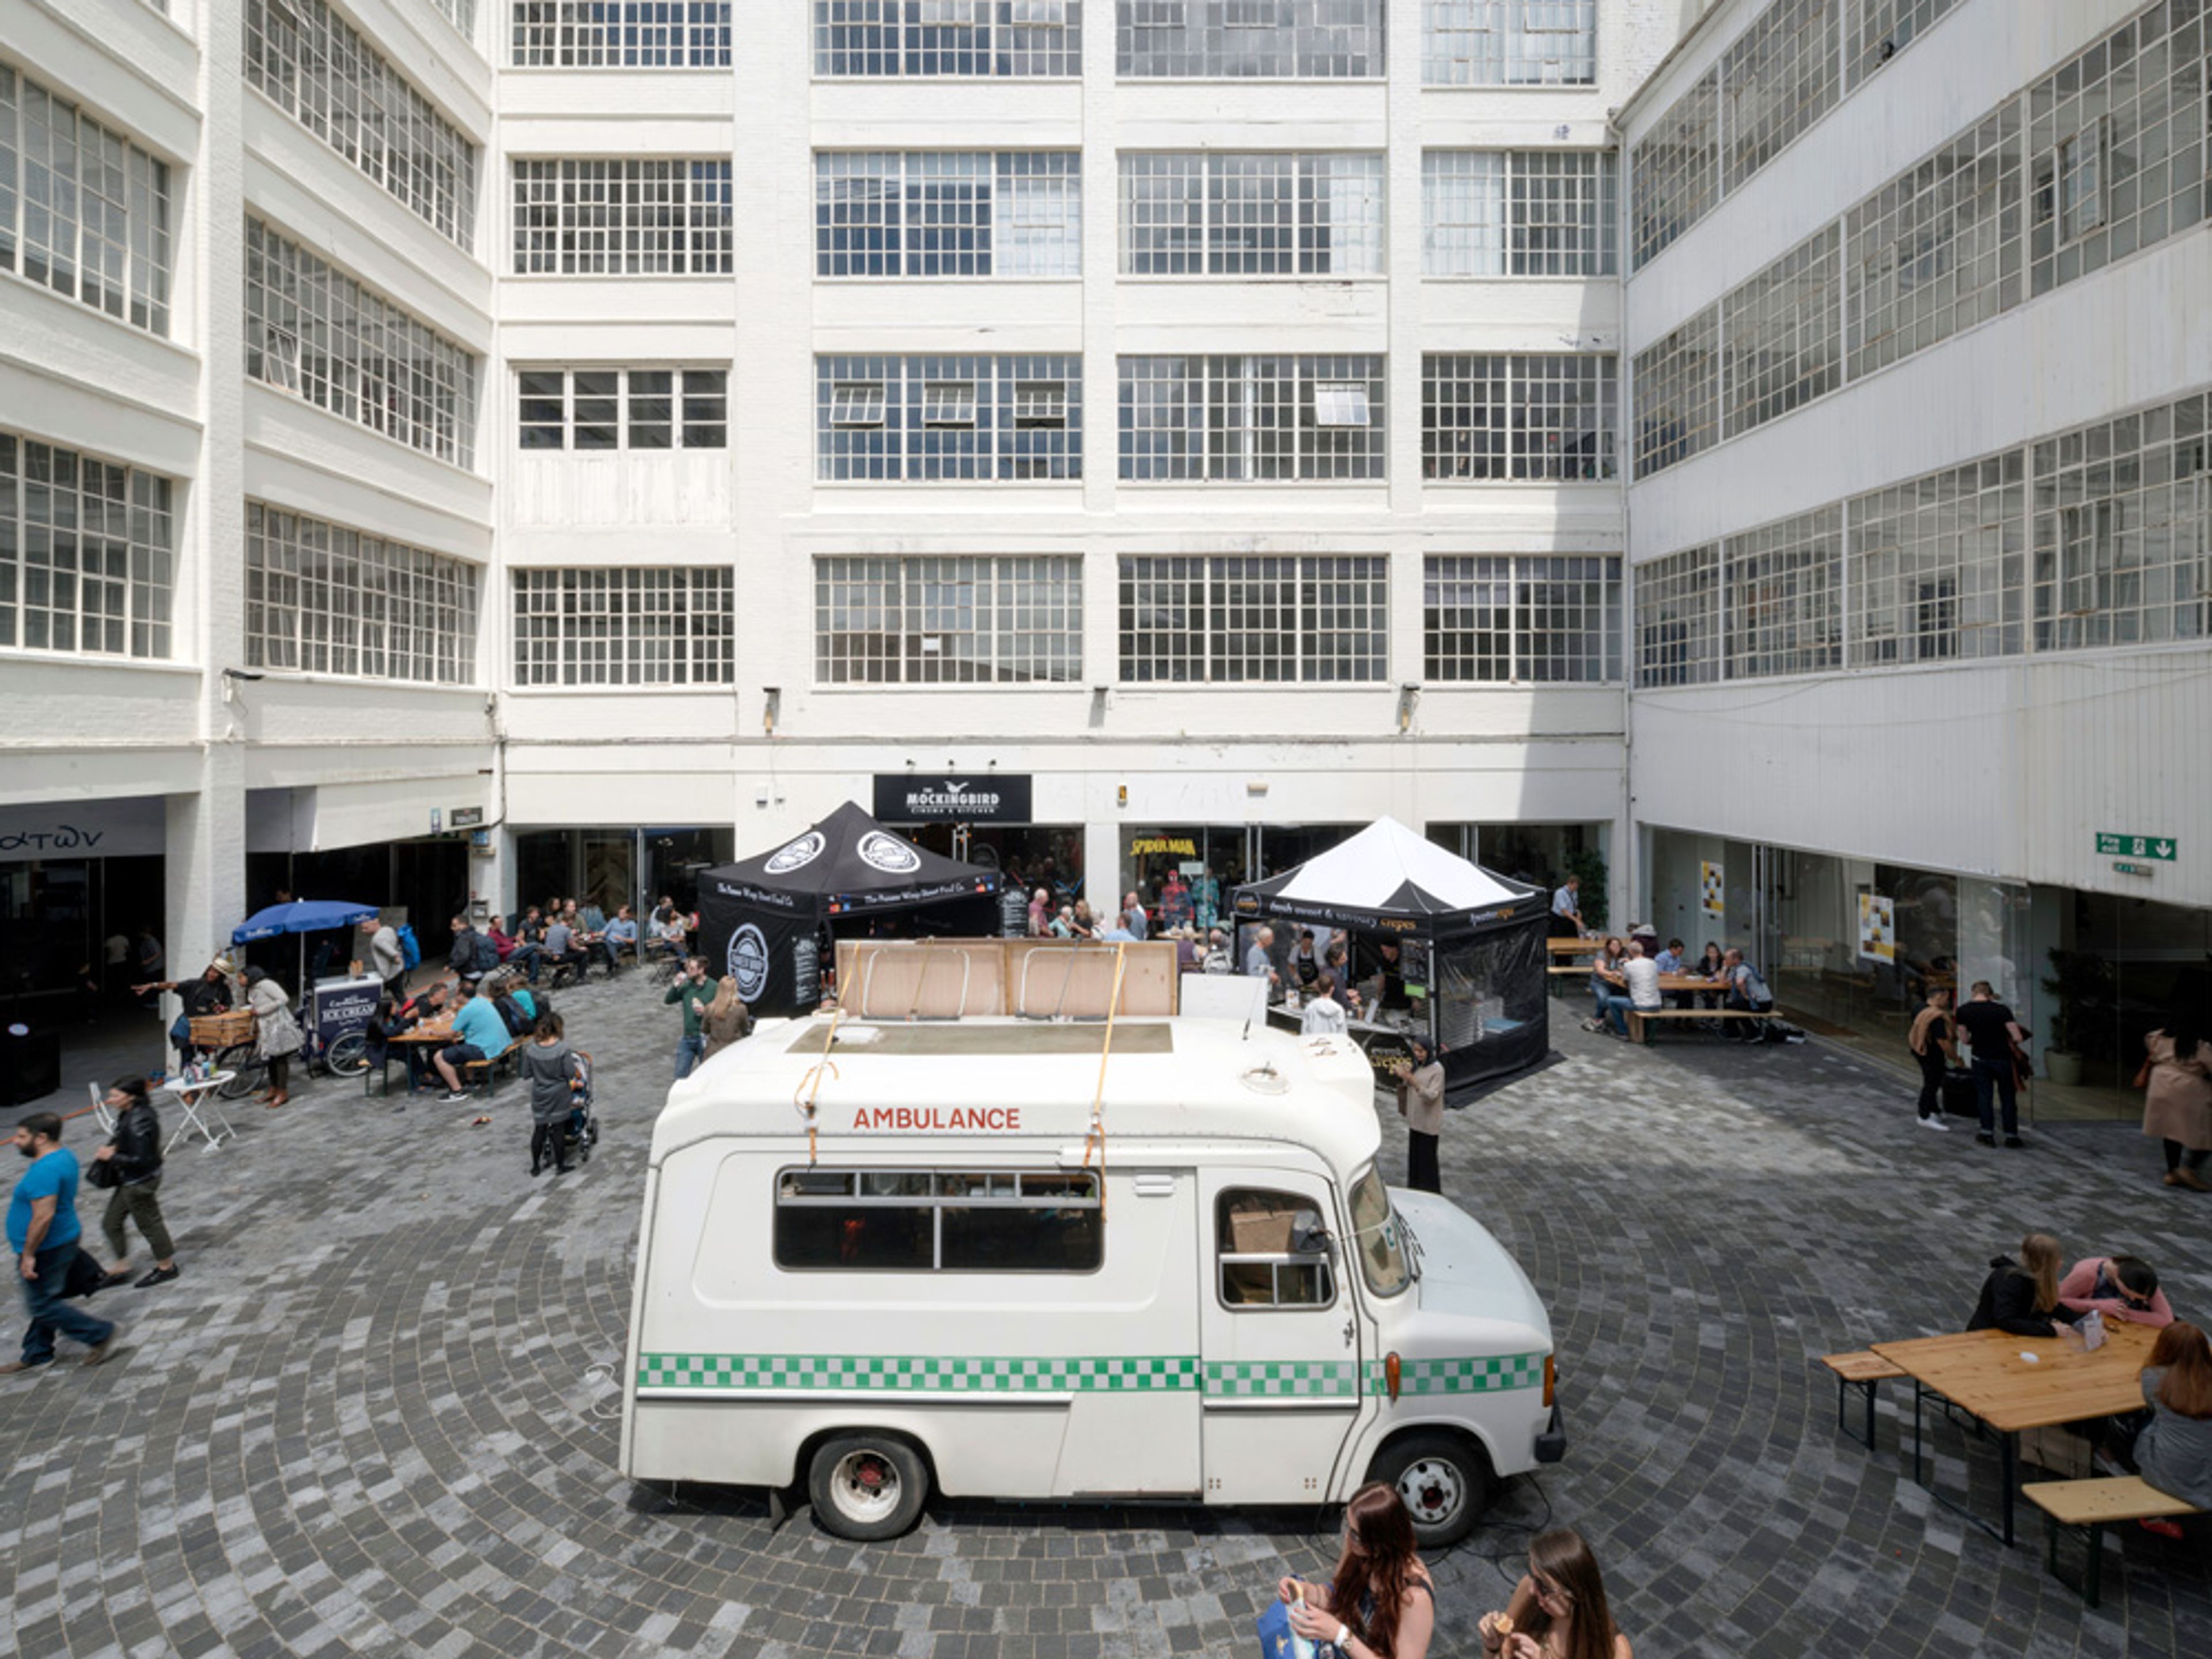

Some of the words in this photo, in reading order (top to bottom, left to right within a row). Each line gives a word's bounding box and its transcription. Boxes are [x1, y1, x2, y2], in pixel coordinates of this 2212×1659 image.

[906, 793, 1000, 805] MOCKINGBIRD
[2101, 836, 2120, 844] Fire
[1325, 908, 1332, 919] &
[853, 1107, 1021, 1129] AMBULANCE
